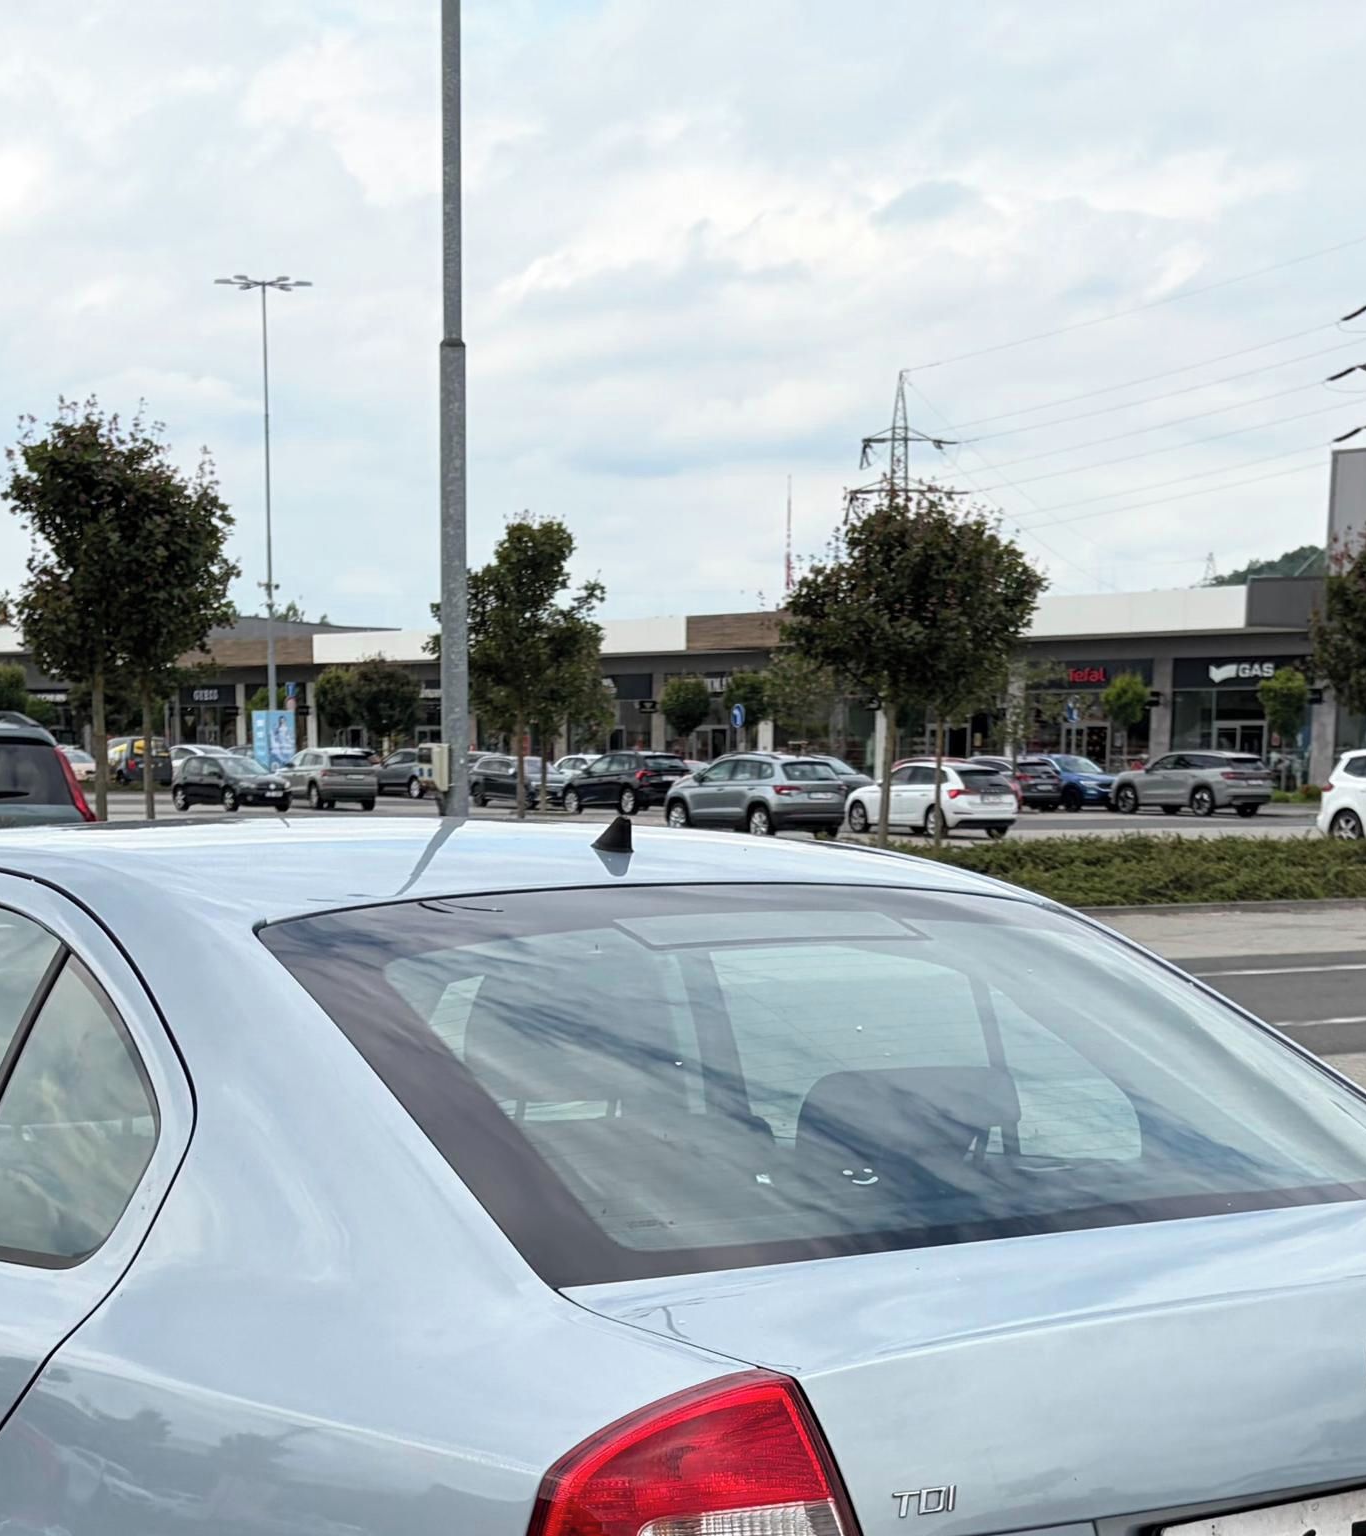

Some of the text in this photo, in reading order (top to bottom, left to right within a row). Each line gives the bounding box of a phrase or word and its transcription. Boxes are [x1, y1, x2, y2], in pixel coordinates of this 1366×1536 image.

[1067, 665, 1106, 682] Tefal
[1238, 662, 1275, 678] GAS
[893, 1485, 956, 1518] TDI
